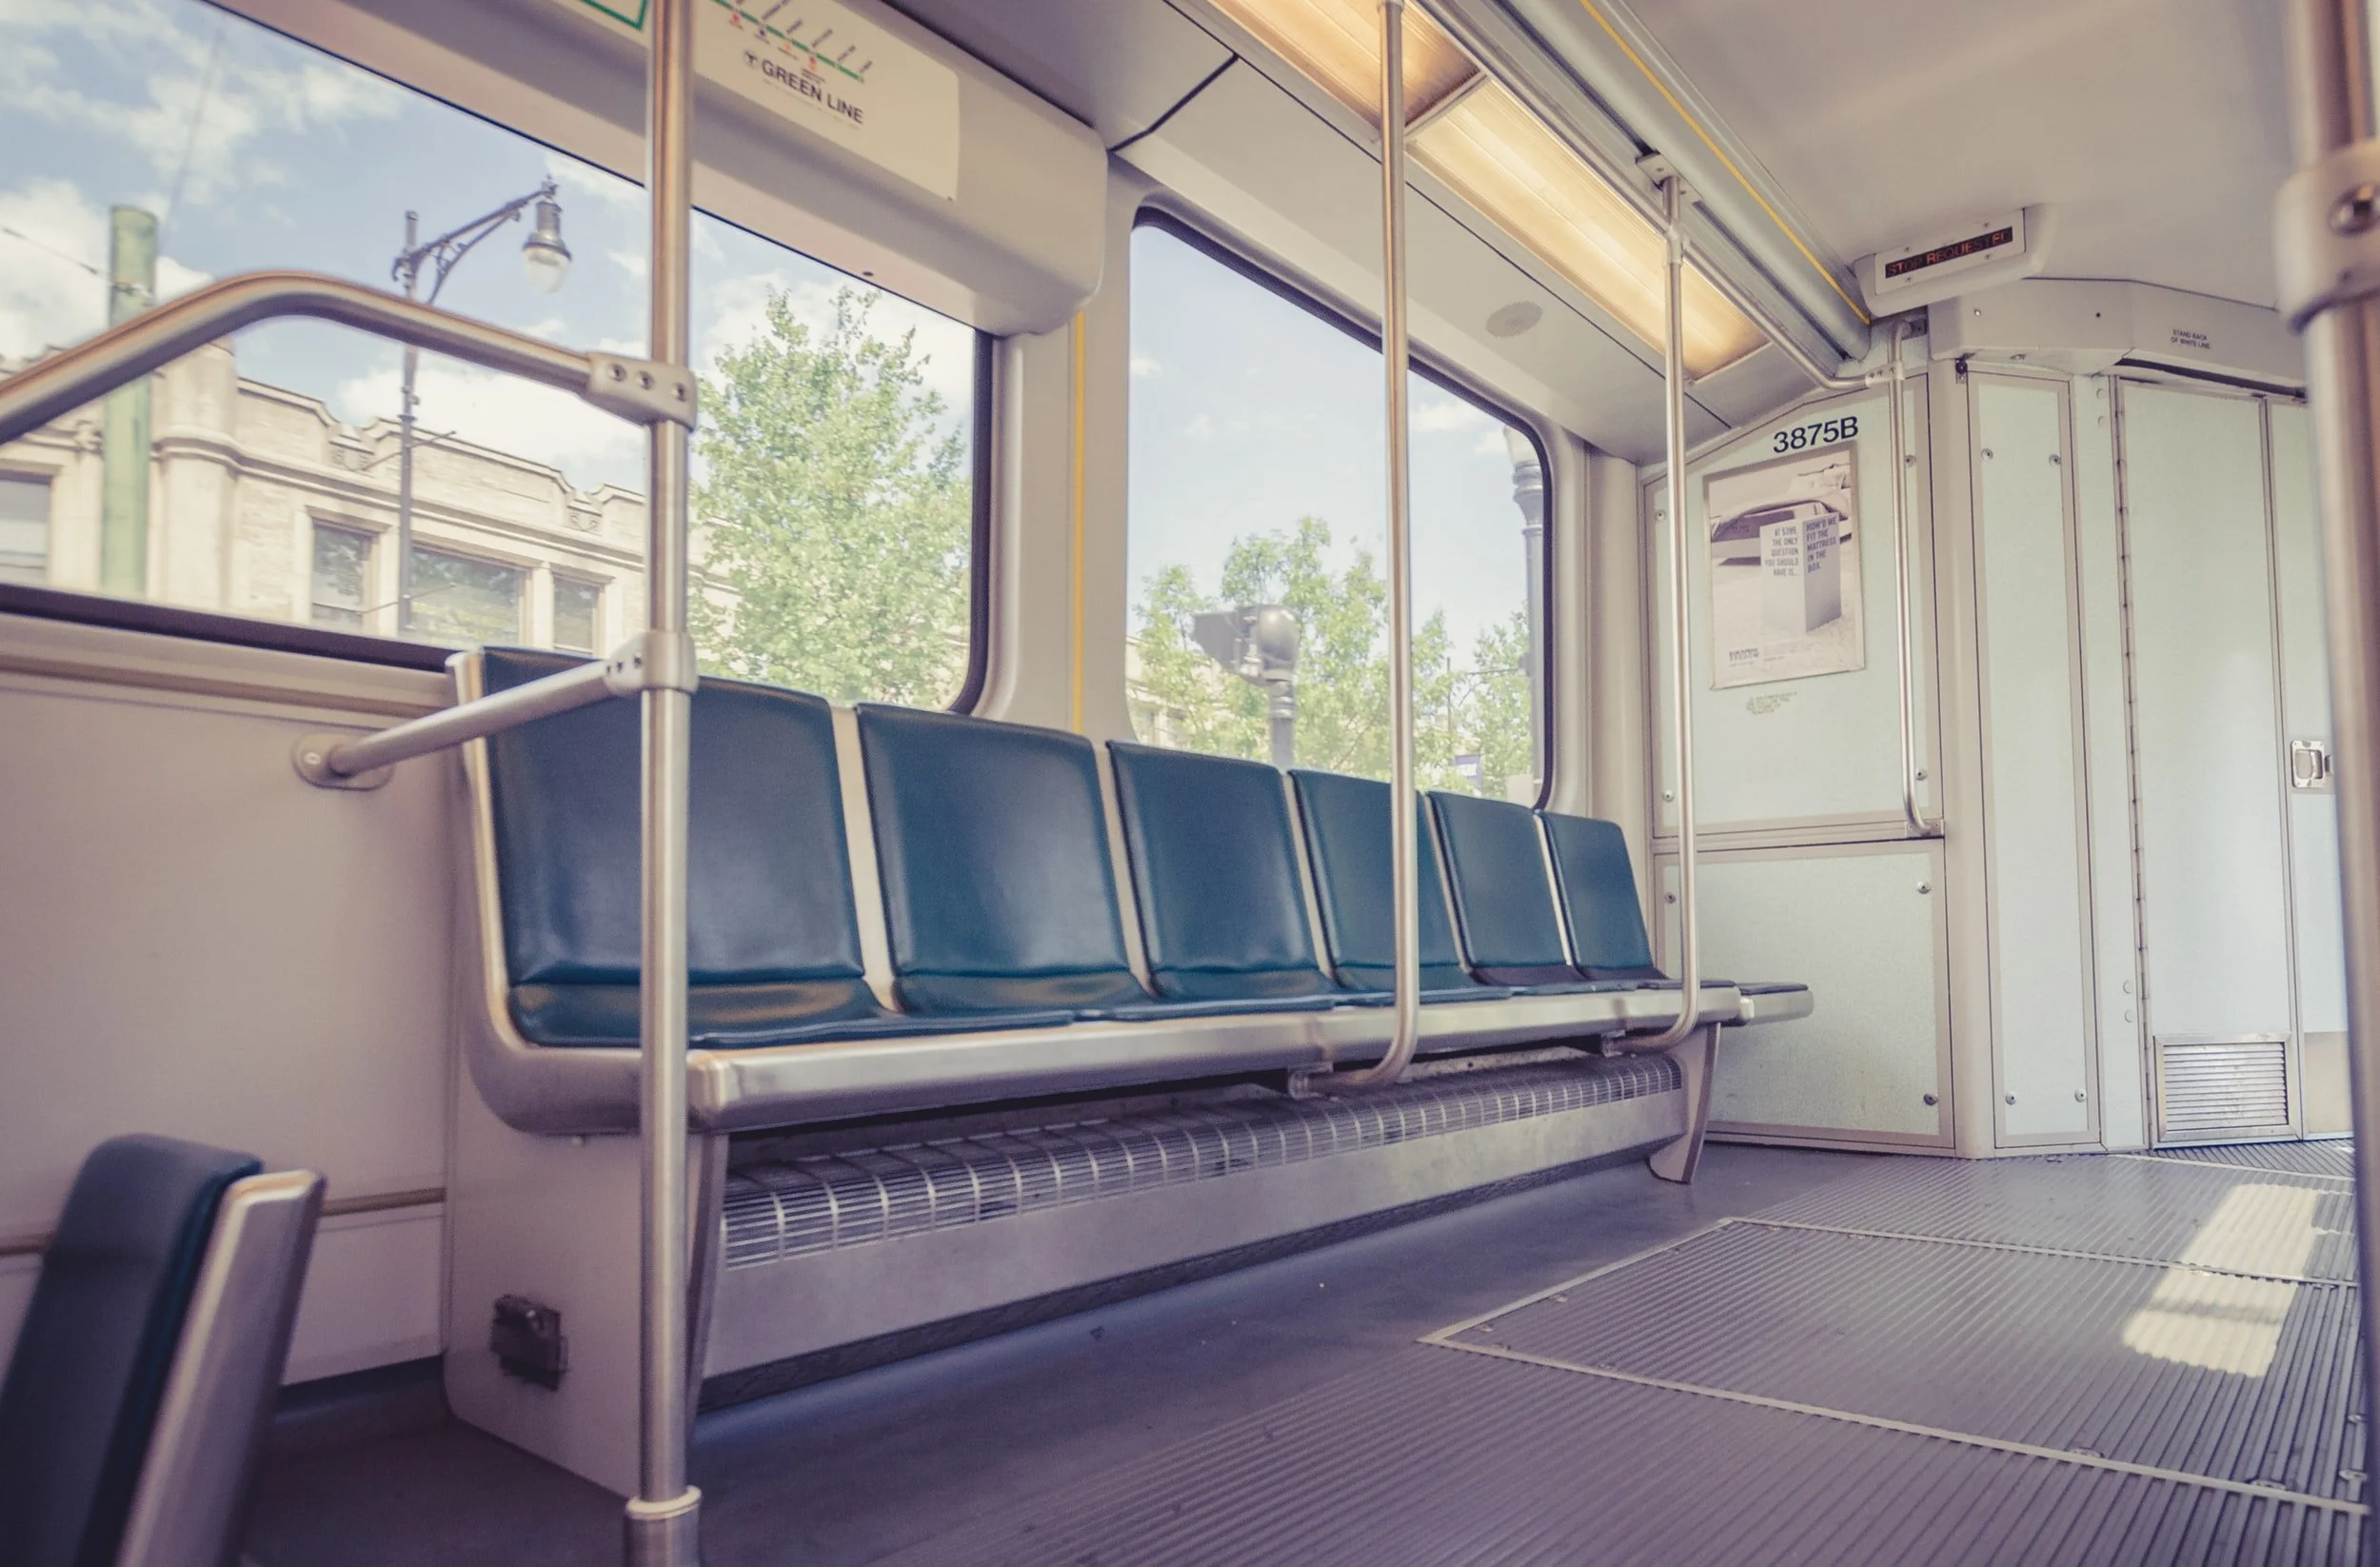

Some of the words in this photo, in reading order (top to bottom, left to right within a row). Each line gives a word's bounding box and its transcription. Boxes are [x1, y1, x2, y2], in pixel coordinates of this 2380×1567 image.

[762, 59, 823, 103] GREEN
[826, 92, 864, 125] LINE
[1888, 256, 1923, 276] STOP
[2172, 328, 2192, 338] STAND
[2192, 331, 2208, 341] BACK
[1773, 415, 1859, 453] 3875B
[1807, 536, 1837, 551] MATTRESS
[1772, 547, 1799, 557] QUESTION
[1776, 558, 1799, 566] SHOULD
